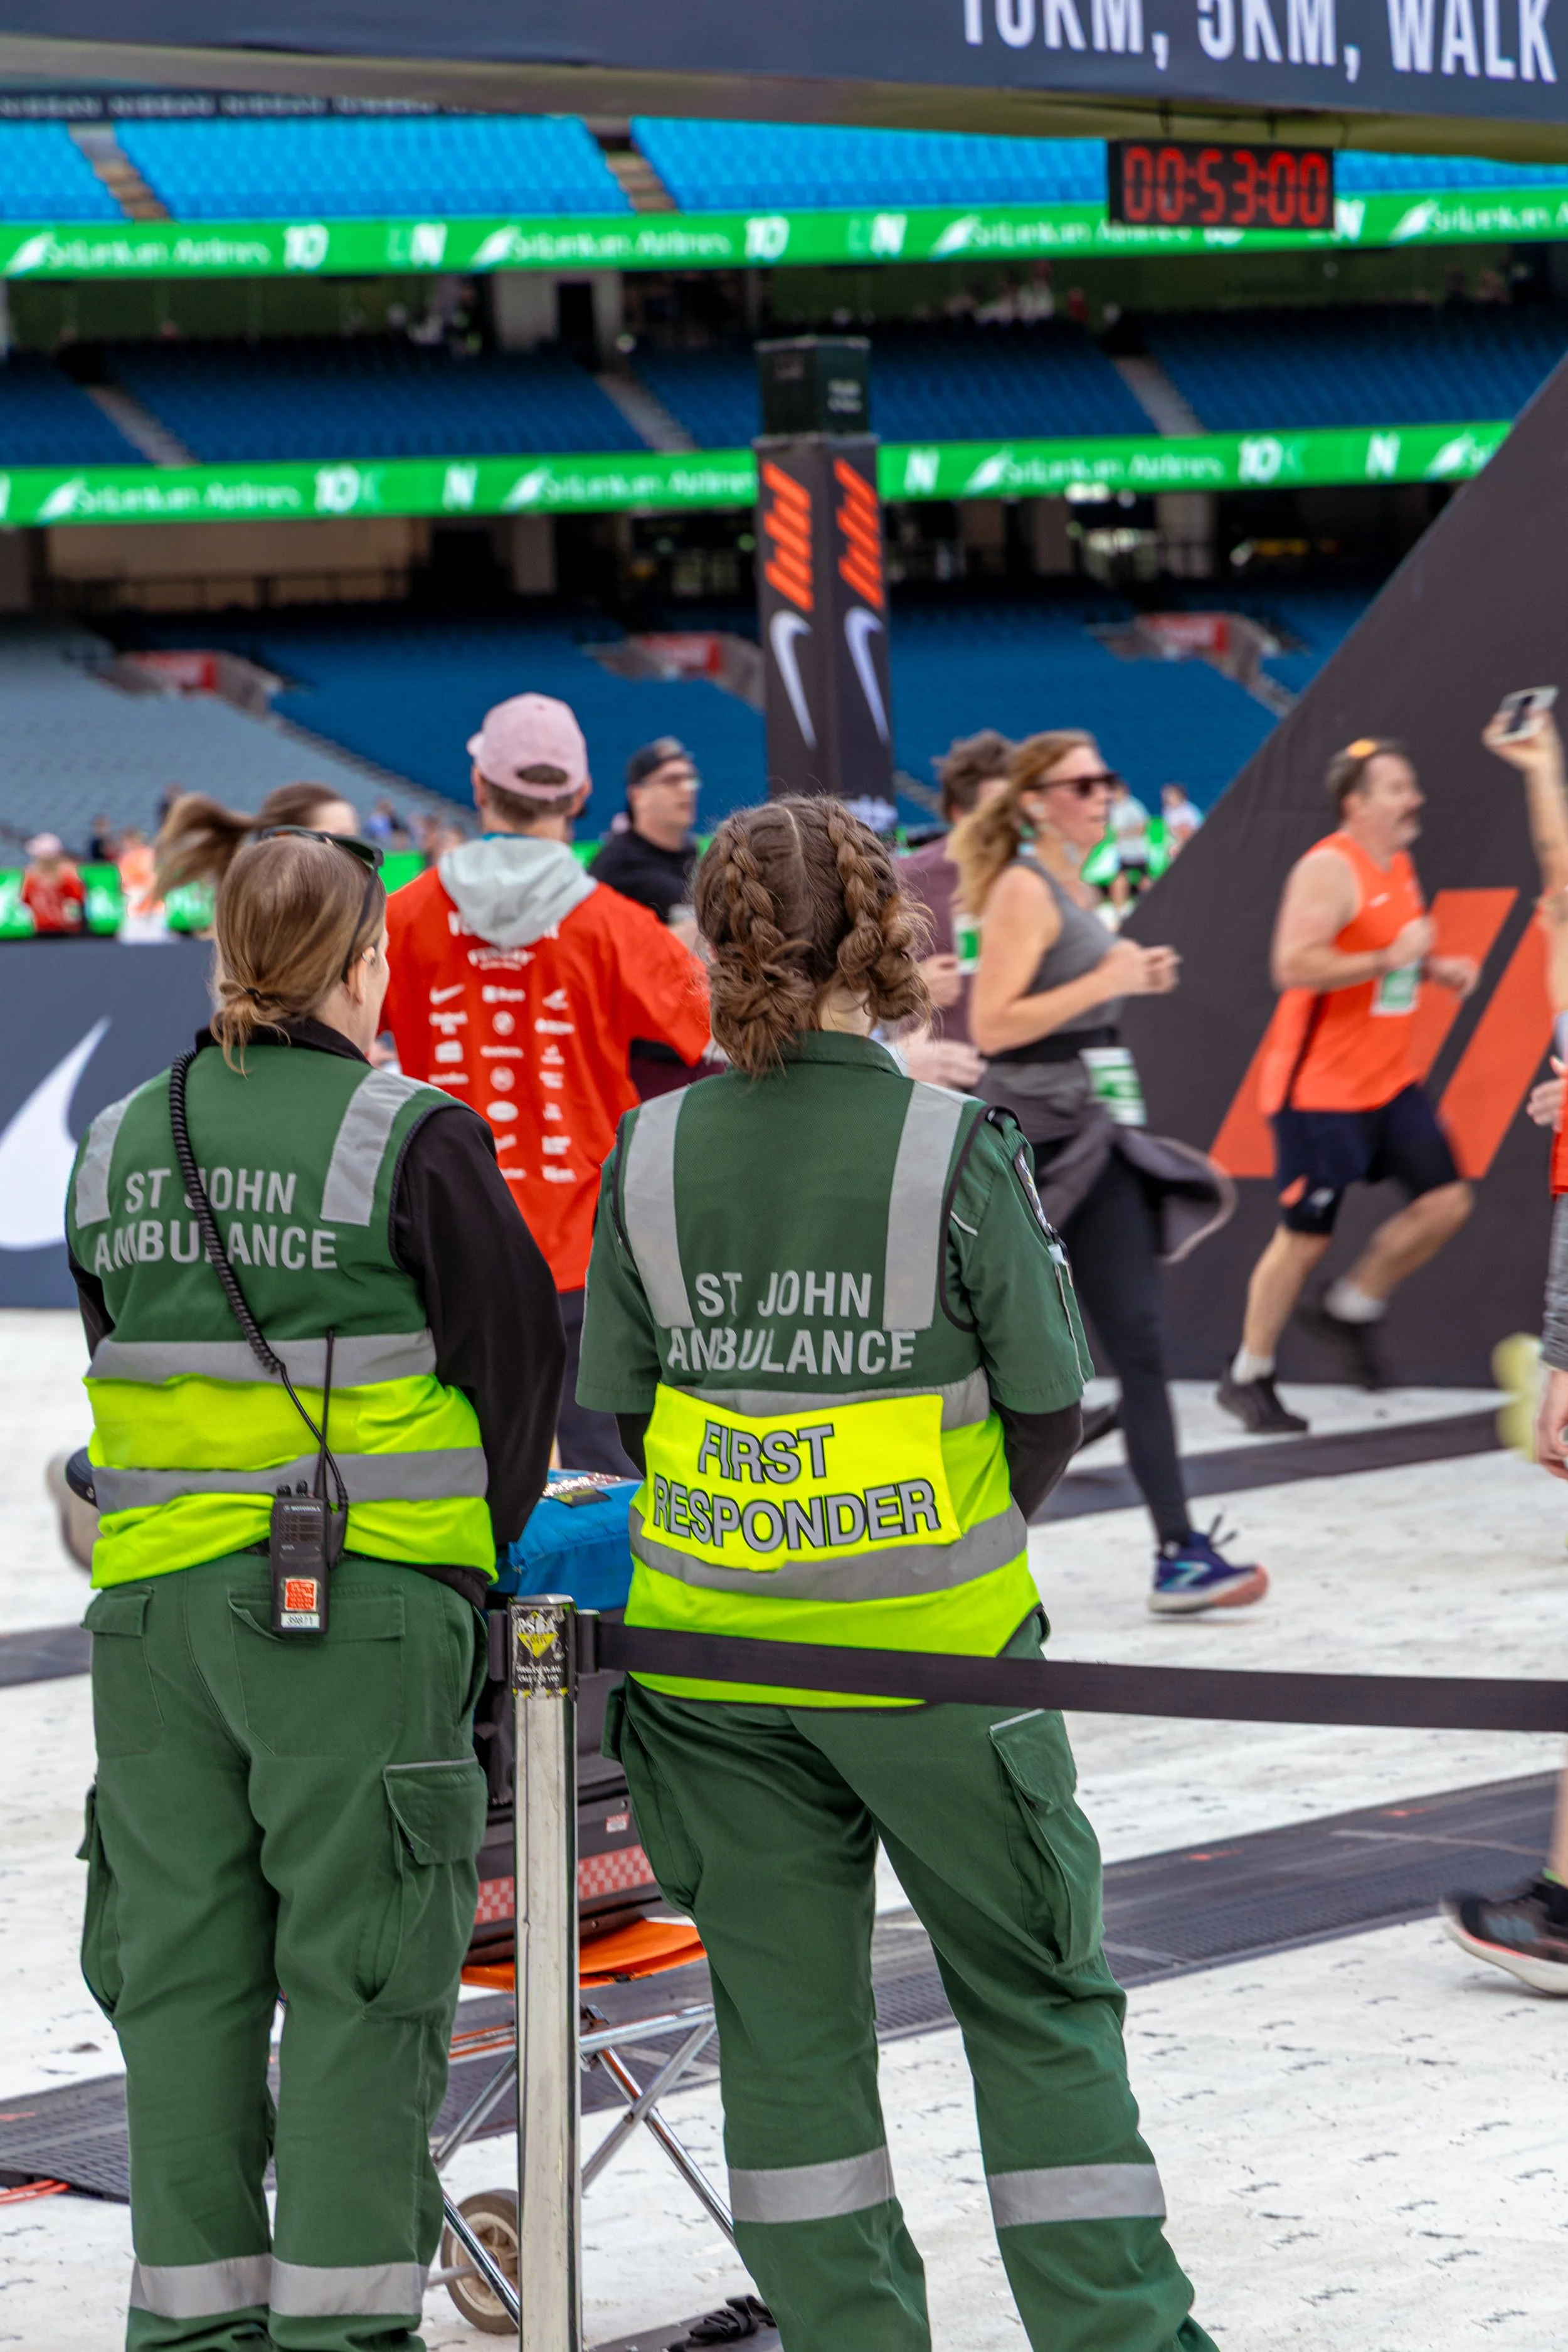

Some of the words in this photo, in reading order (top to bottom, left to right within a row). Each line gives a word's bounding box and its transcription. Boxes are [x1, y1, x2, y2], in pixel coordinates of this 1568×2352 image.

[1197, 0, 1360, 83] 5KM,
[1386, 0, 1557, 83] WALK
[1123, 146, 1328, 226] 00:53:00
[125, 1167, 172, 1214] ST
[94, 1219, 338, 1273] AMBUANCE
[695, 1271, 743, 1317] ST
[757, 1269, 872, 1318] JOHN
[667, 1325, 916, 1375] AMBULANCE
[697, 1419, 835, 1485] FIRST
[652, 1471, 942, 1554] RESPONDER
